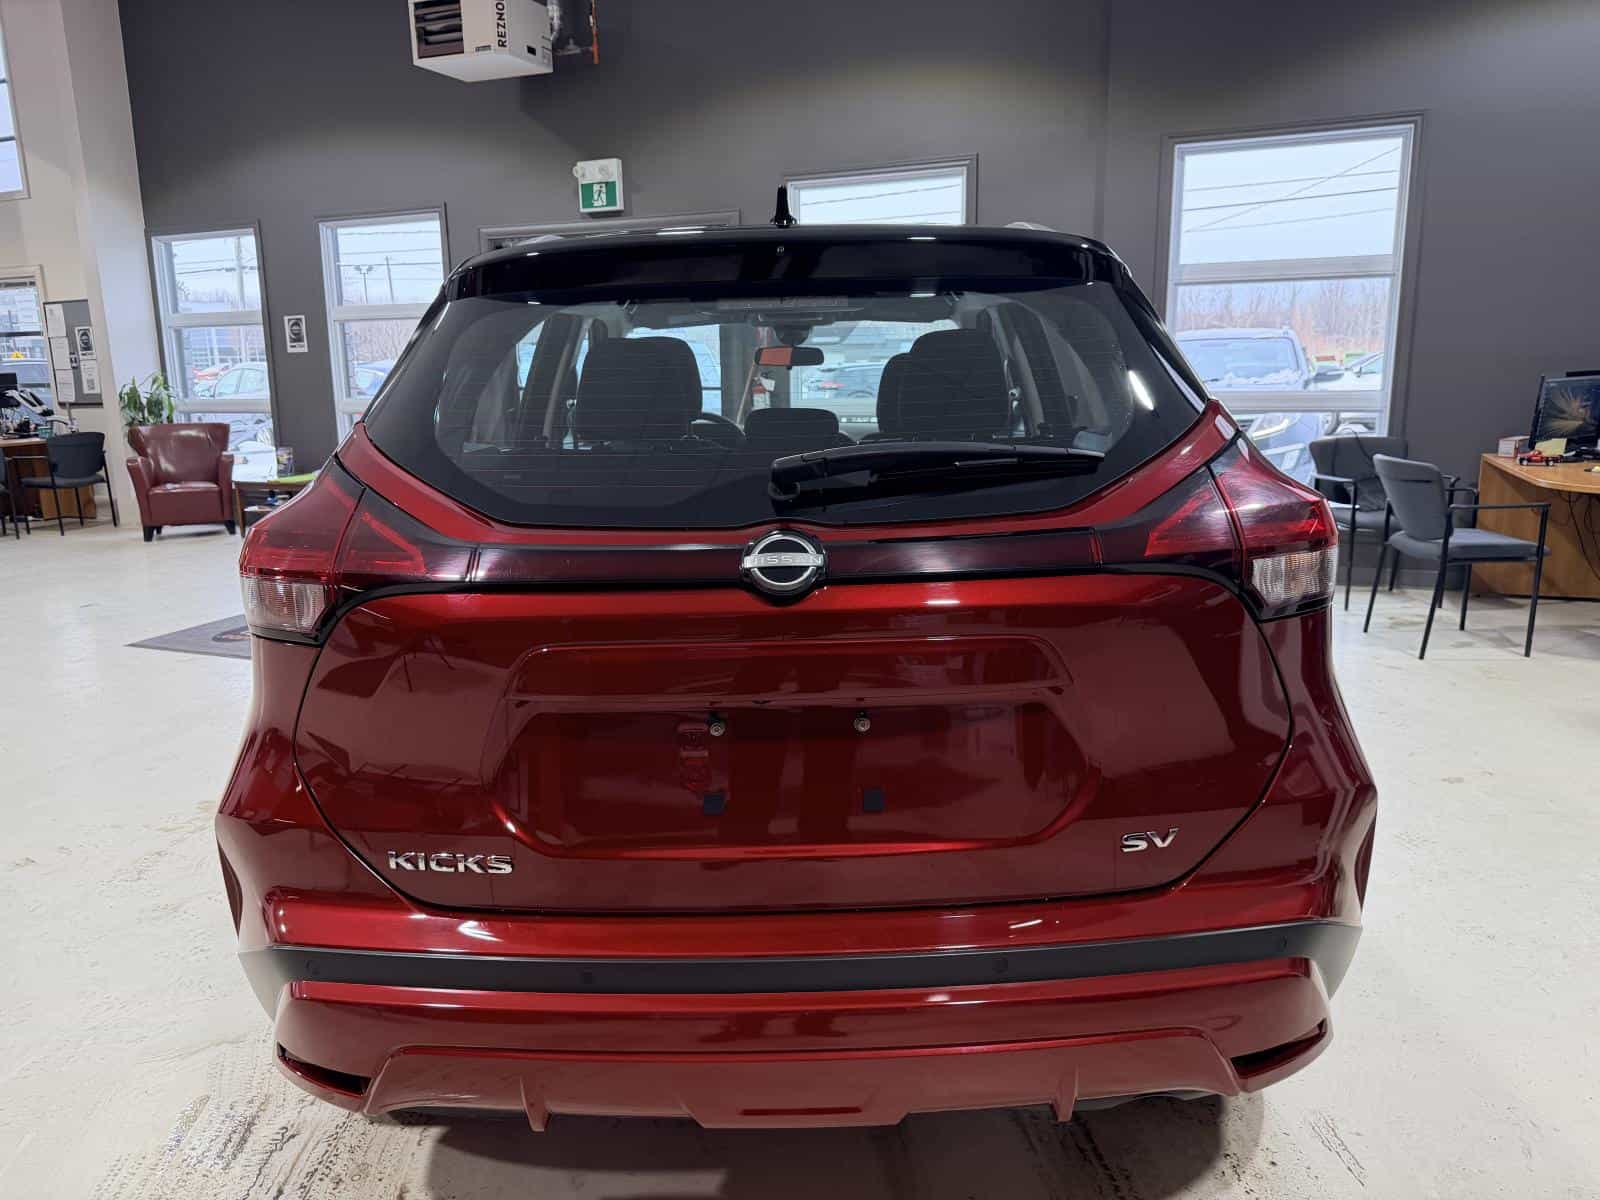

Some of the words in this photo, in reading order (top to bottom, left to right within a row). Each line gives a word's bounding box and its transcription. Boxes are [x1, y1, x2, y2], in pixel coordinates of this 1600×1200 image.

[495, 0, 507, 48] REZNO
[1121, 828, 1179, 853] SV
[387, 850, 513, 874] KICKS
